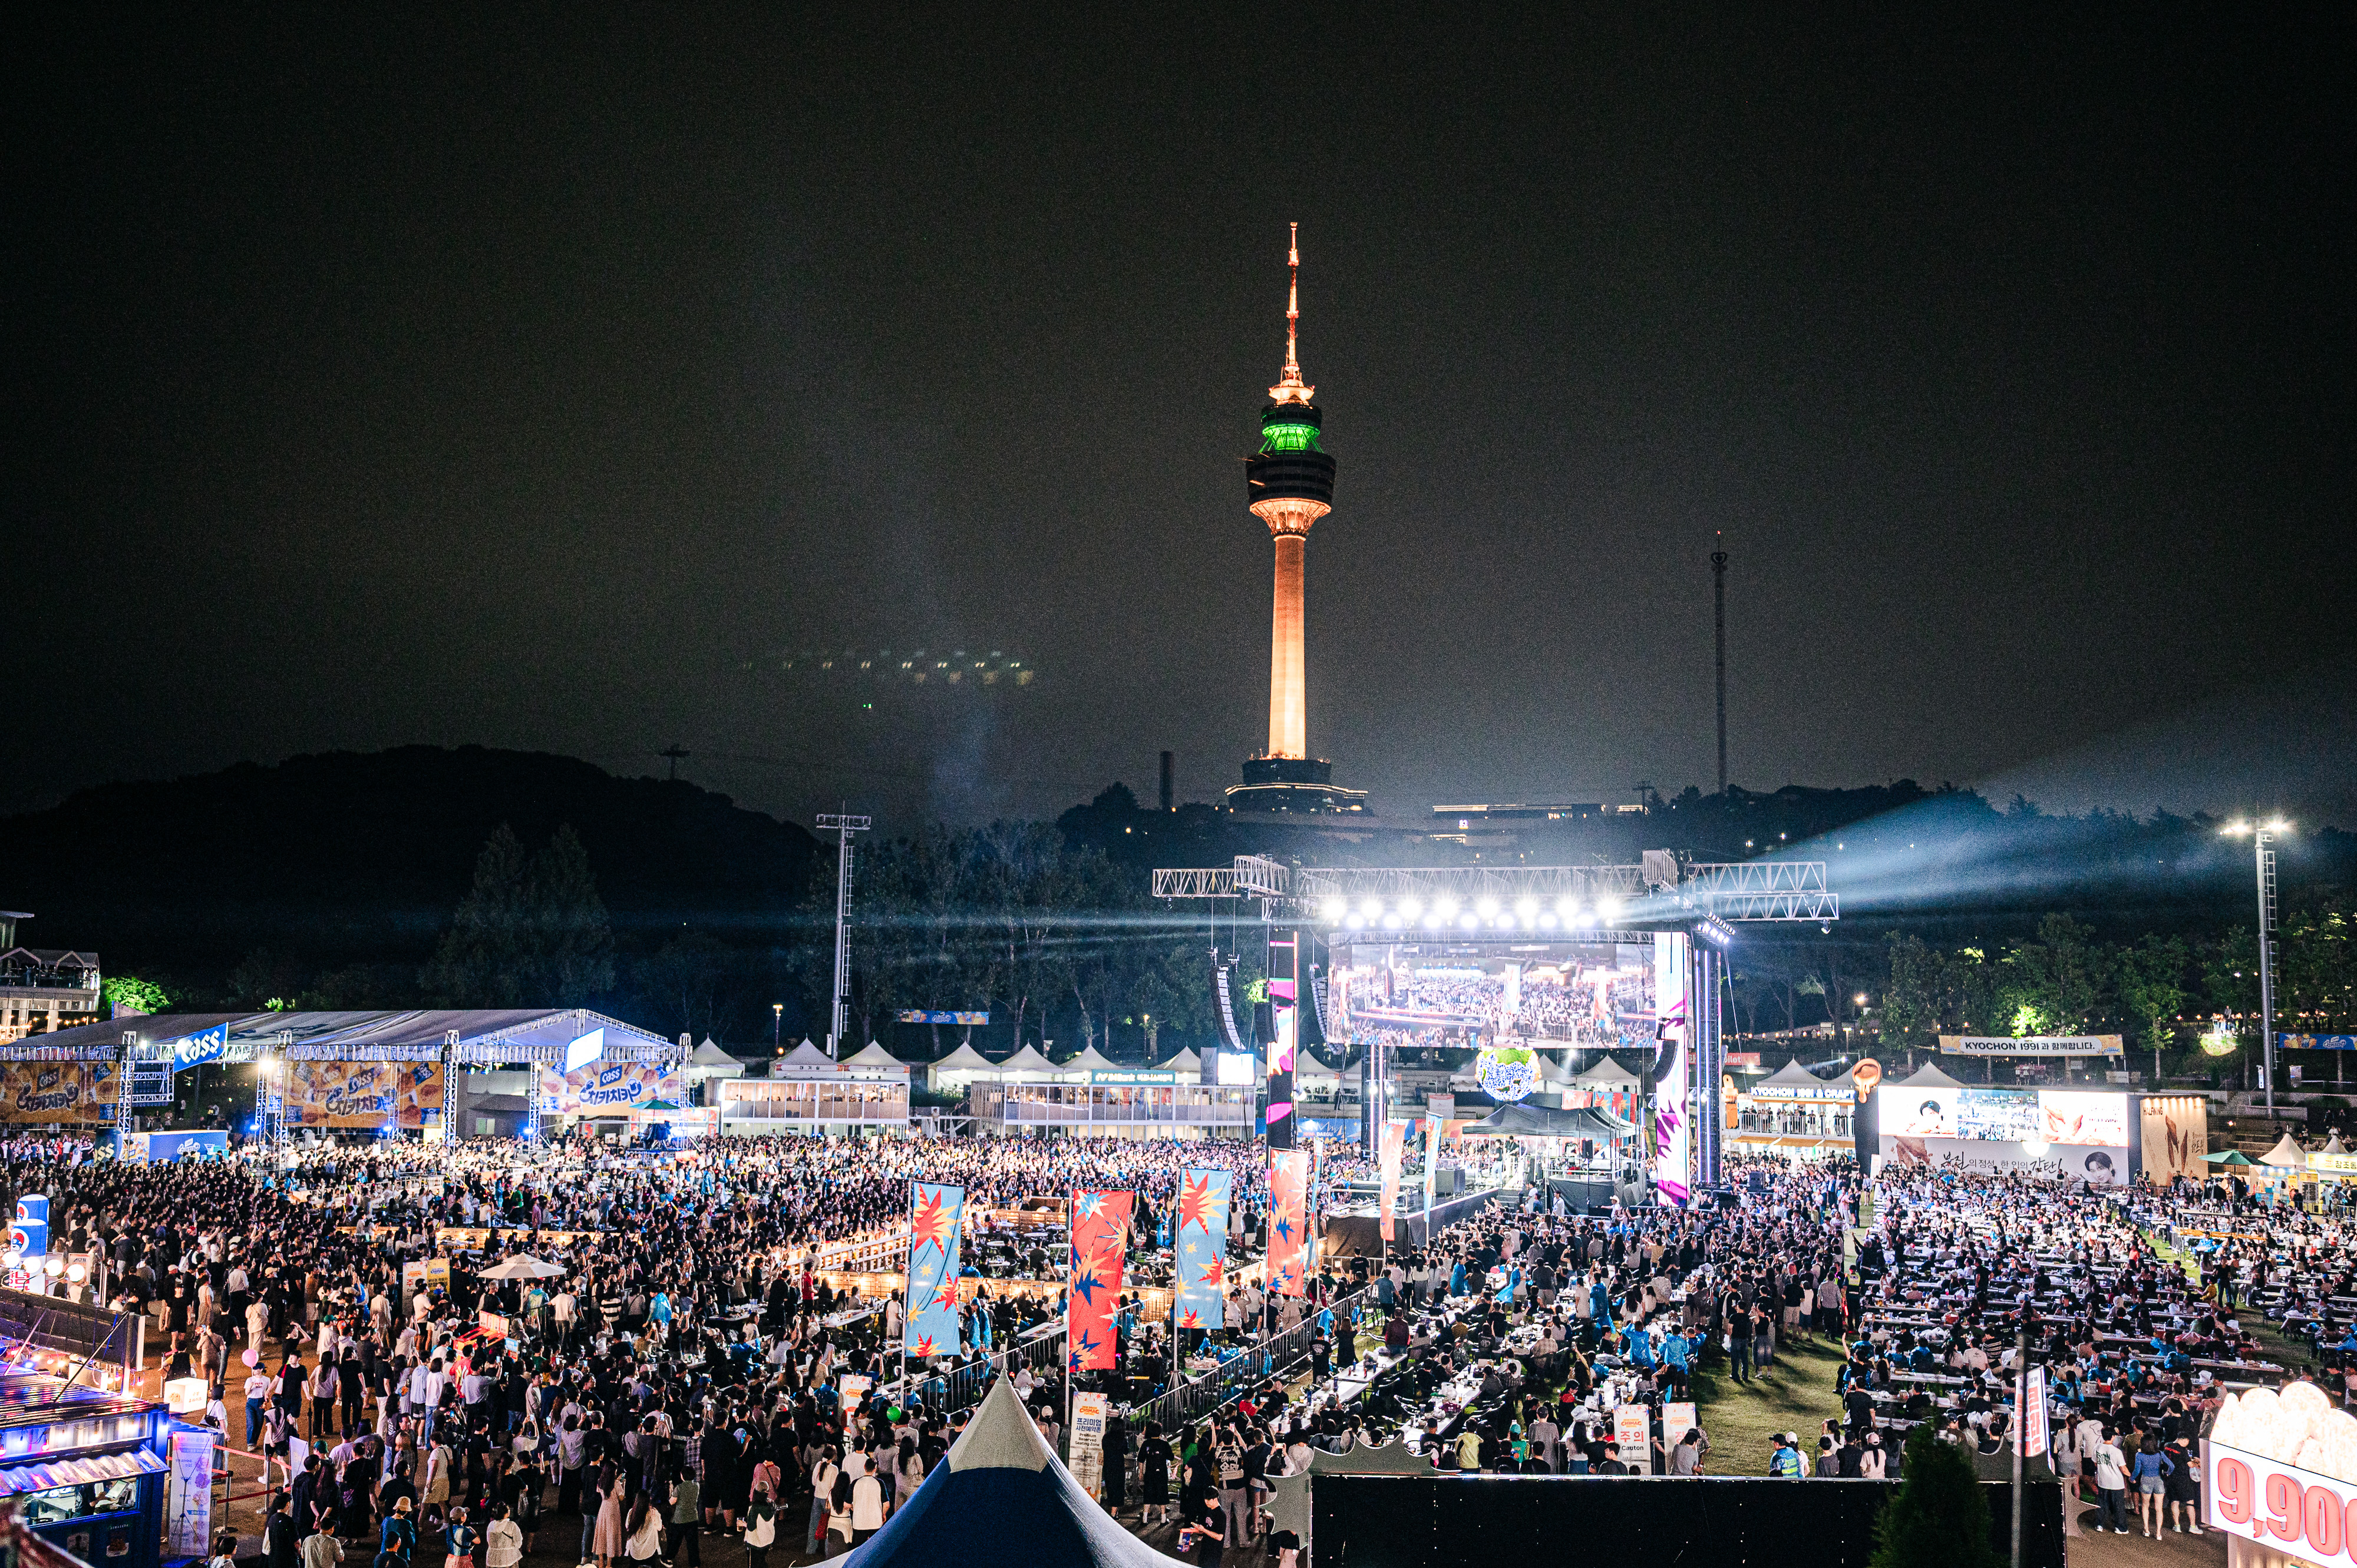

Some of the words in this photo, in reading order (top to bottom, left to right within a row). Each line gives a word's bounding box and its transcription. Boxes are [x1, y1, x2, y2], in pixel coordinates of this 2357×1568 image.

[1965, 1042, 2016, 1050] KYOCHON
[2041, 1042, 2049, 1050] 과
[2052, 1041, 2095, 1050] 함께합니다.
[1751, 1087, 1794, 1097] KYOCHON
[1824, 1090, 1854, 1098] CRAFT
[2001, 1160, 2009, 1168] 한
[1077, 1418, 1101, 1427] 프리미엄
[1075, 1425, 1101, 1433] 사전예약존
[1620, 1431, 1644, 1442] 주의
[2217, 1458, 2357, 1565] 9,90
